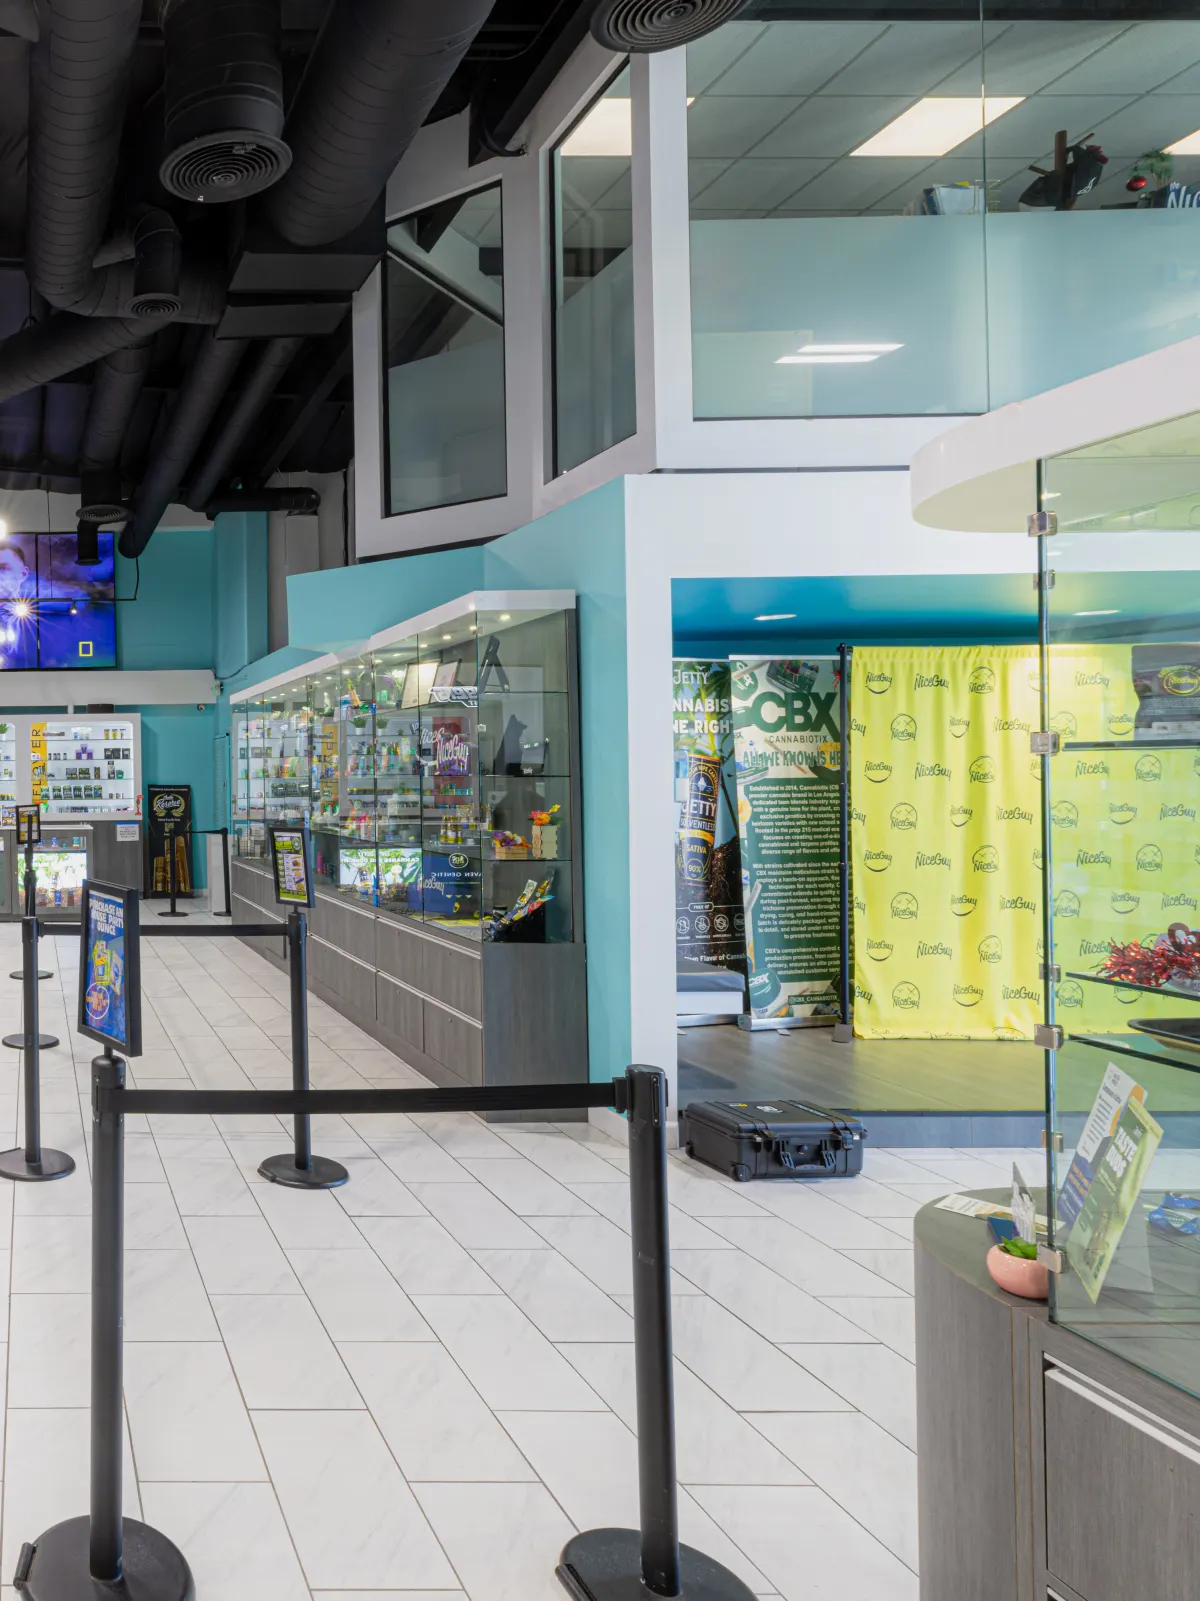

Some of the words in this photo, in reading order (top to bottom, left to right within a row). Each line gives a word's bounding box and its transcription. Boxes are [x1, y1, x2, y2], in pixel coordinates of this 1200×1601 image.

[673, 665, 709, 685] JETTY
[866, 672, 892, 685] NiceGuy
[1075, 671, 1110, 688] NiceGuy
[672, 698, 730, 713] NNABIS
[751, 690, 845, 744] CBX
[694, 719, 731, 734] RIGH
[993, 716, 1031, 735] NiceGuy
[769, 735, 829, 744] CANNABIOTIX
[891, 728, 917, 741] NiceGuy
[865, 761, 892, 773] NiceGuy
[915, 762, 951, 781] NiceGuy
[1136, 769, 1161, 782] NiceGuy
[154, 798, 181, 811] Reserve
[682, 798, 717, 817] JETTY
[1109, 803, 1138, 814] NiceGuy
[1159, 803, 1197, 821] NiceGuy
[681, 818, 716, 832] SOLVENTLESS
[891, 817, 917, 830] NiceGuy
[686, 843, 707, 855] SATIVA
[864, 850, 892, 862] NiceGuy
[915, 852, 951, 870] NiceGuy
[1076, 850, 1111, 869] NiceGuy
[1137, 860, 1163, 872] NiceGuy
[1111, 892, 1140, 905] NiceGuy
[1161, 892, 1198, 911] NiceGuy
[89, 899, 116, 916] PURCHASE
[892, 906, 918, 920] NiceGuy
[97, 921, 116, 936] OUNCE
[867, 939, 893, 952] NiceGuy
[917, 941, 952, 960] NiceGuy
[953, 984, 984, 998] NiceGuy
[893, 997, 919, 1010] NiceGuy
[1114, 1126, 1138, 1163] TASTE
